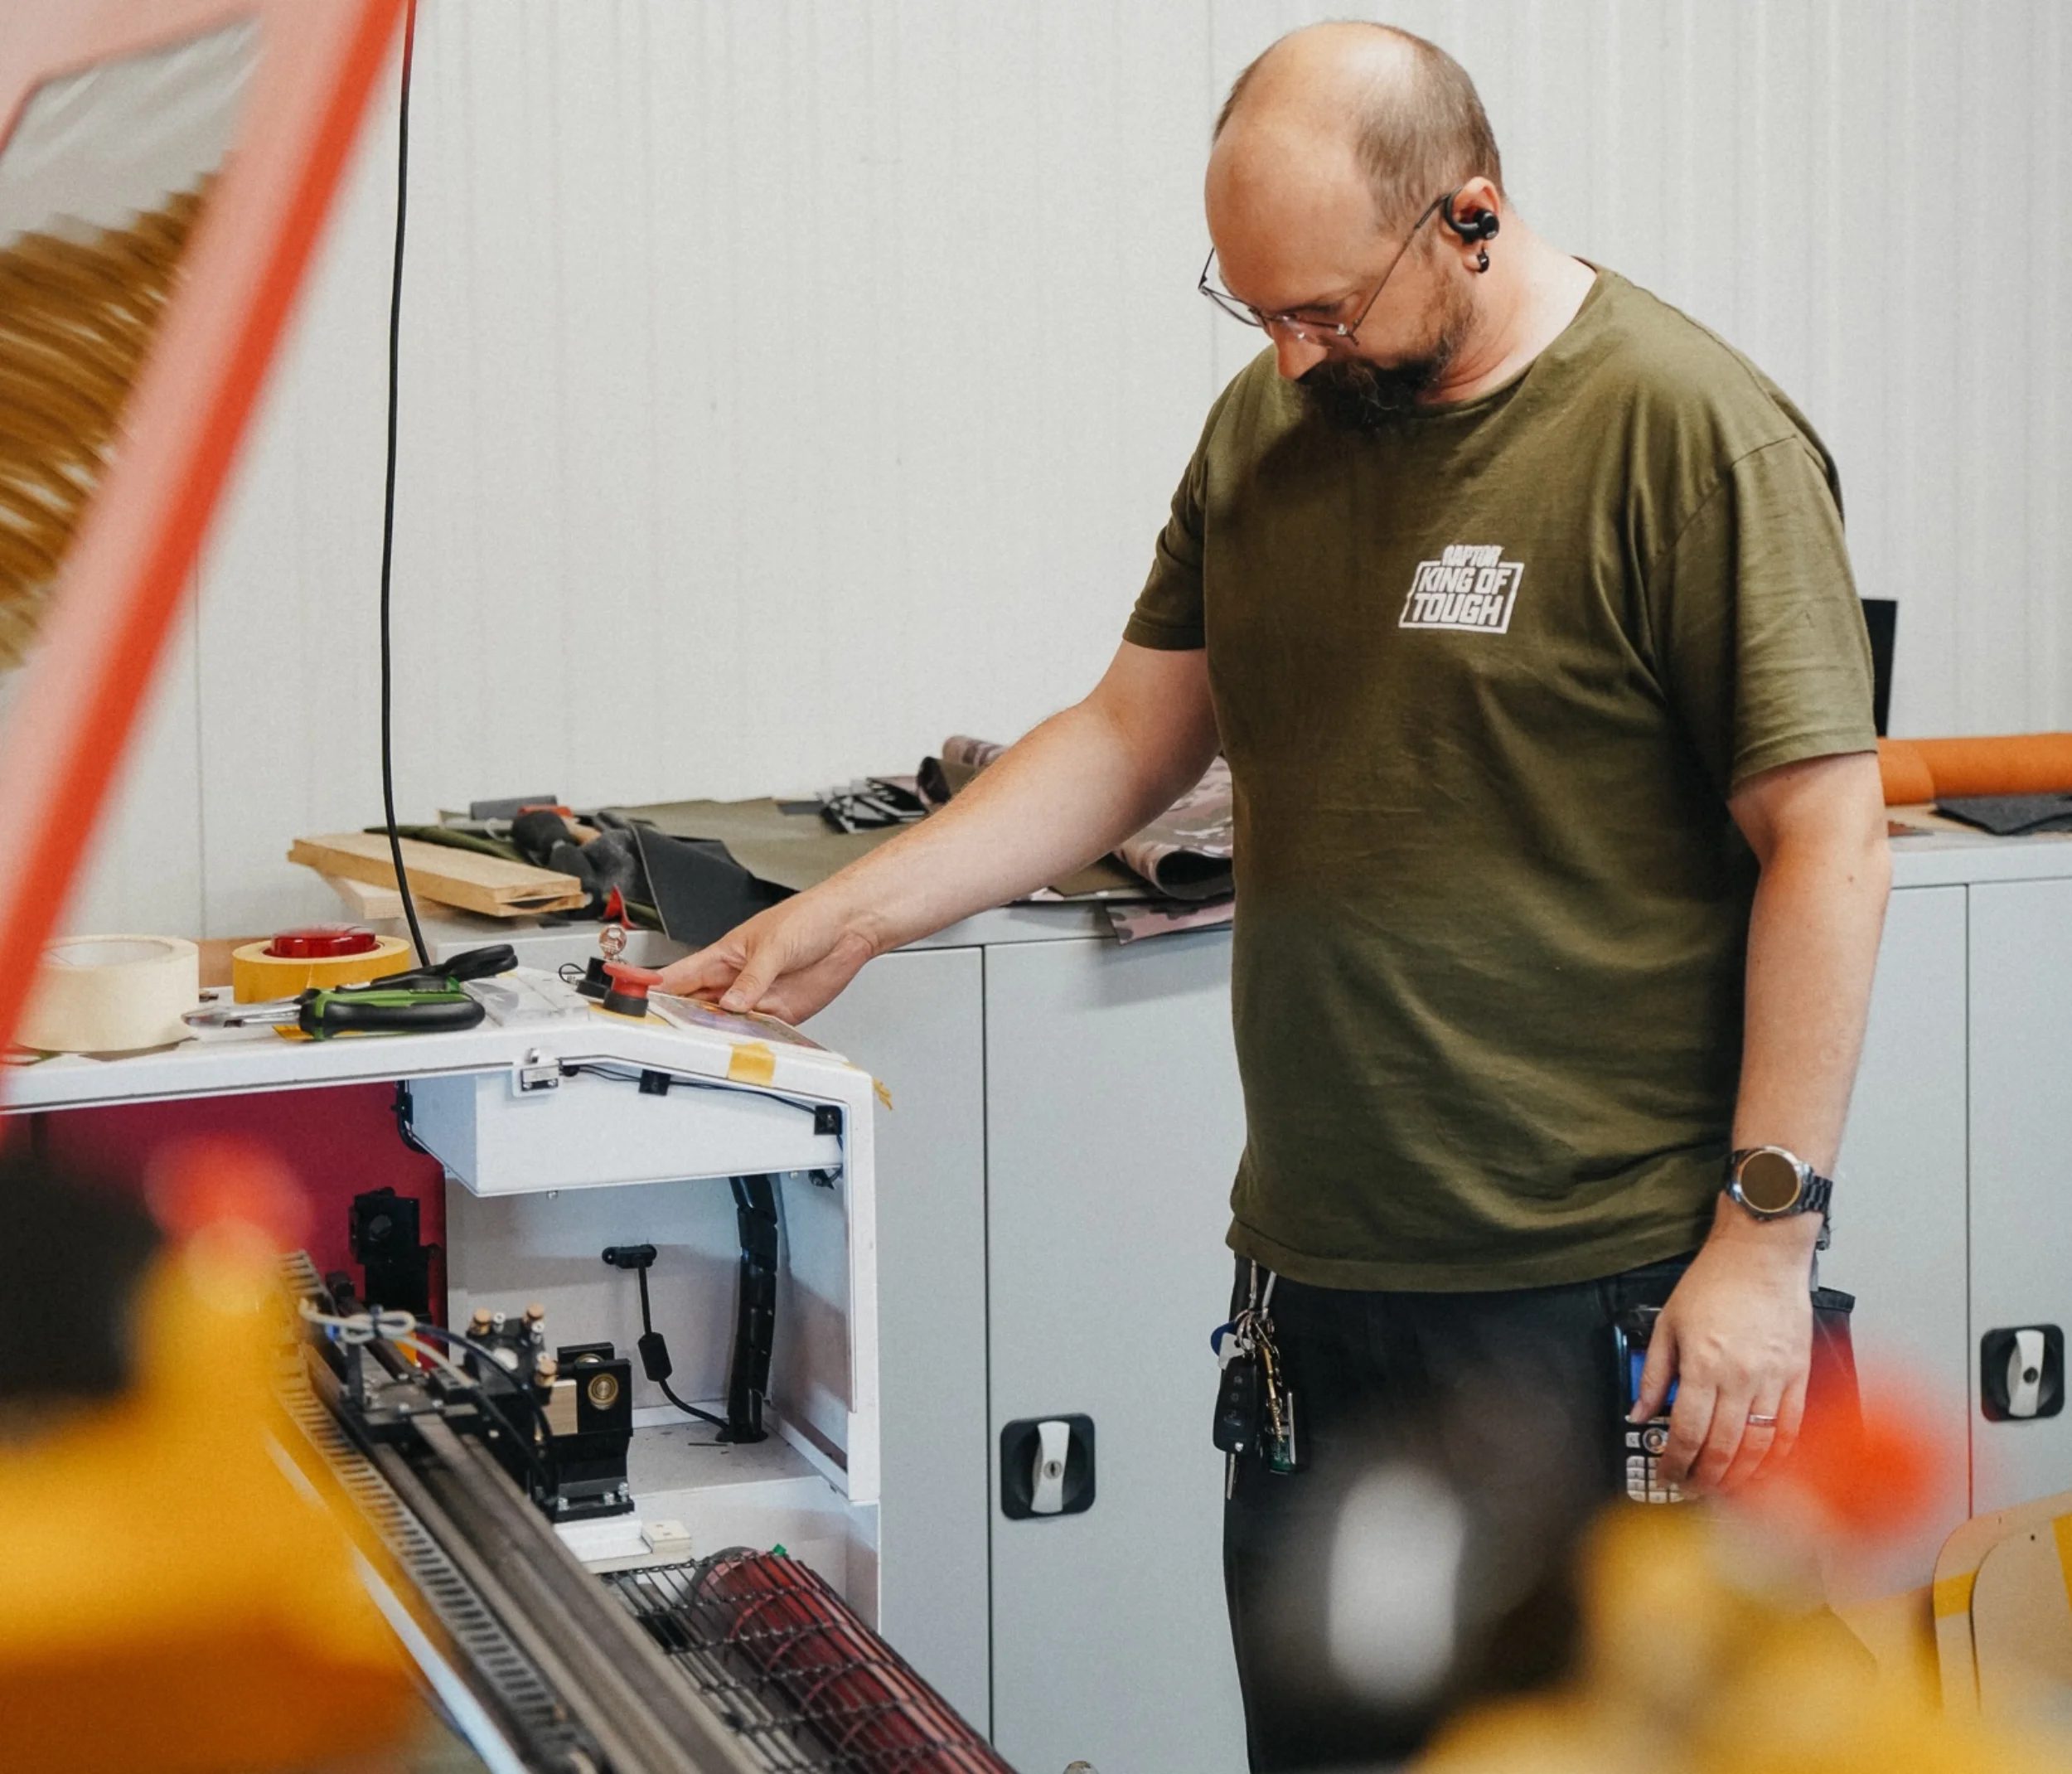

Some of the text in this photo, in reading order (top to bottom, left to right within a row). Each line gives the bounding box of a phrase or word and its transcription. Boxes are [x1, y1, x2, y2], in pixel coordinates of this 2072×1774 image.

[1418, 567, 1512, 594] KING OF
[1412, 593, 1504, 625] TOUGH
